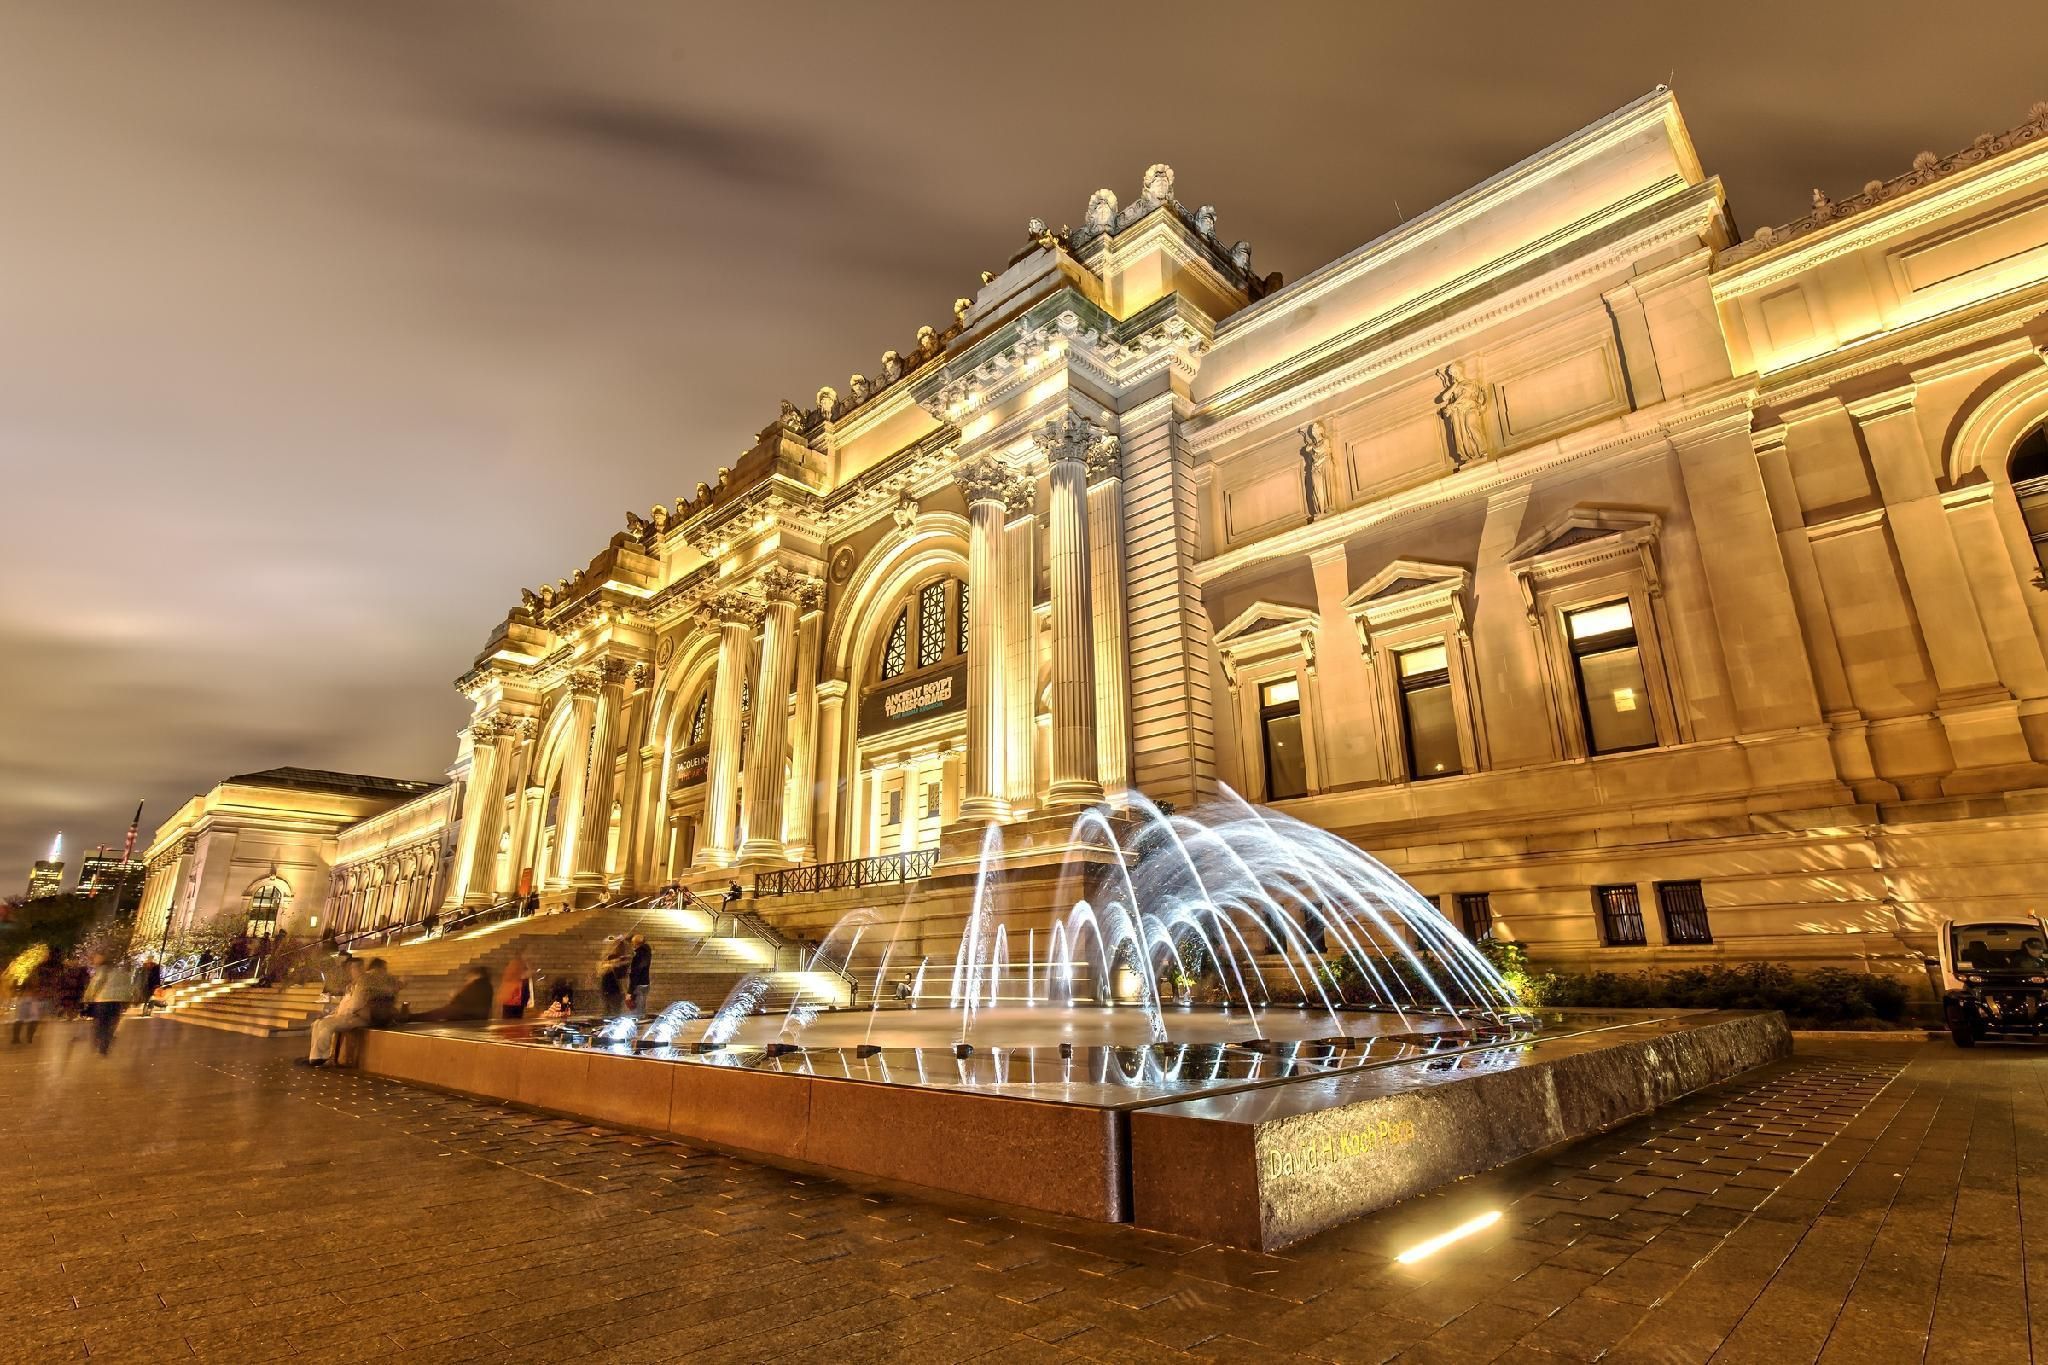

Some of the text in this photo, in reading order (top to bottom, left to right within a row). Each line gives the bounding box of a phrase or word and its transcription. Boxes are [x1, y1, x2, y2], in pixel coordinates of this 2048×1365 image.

[885, 677, 953, 706] ANCIENT EGYPT
[885, 688, 952, 717] TRANSFORMED
[1269, 1139, 1318, 1179] David
[1340, 1123, 1376, 1159] Koch
[1378, 1117, 1415, 1144] Plaza
